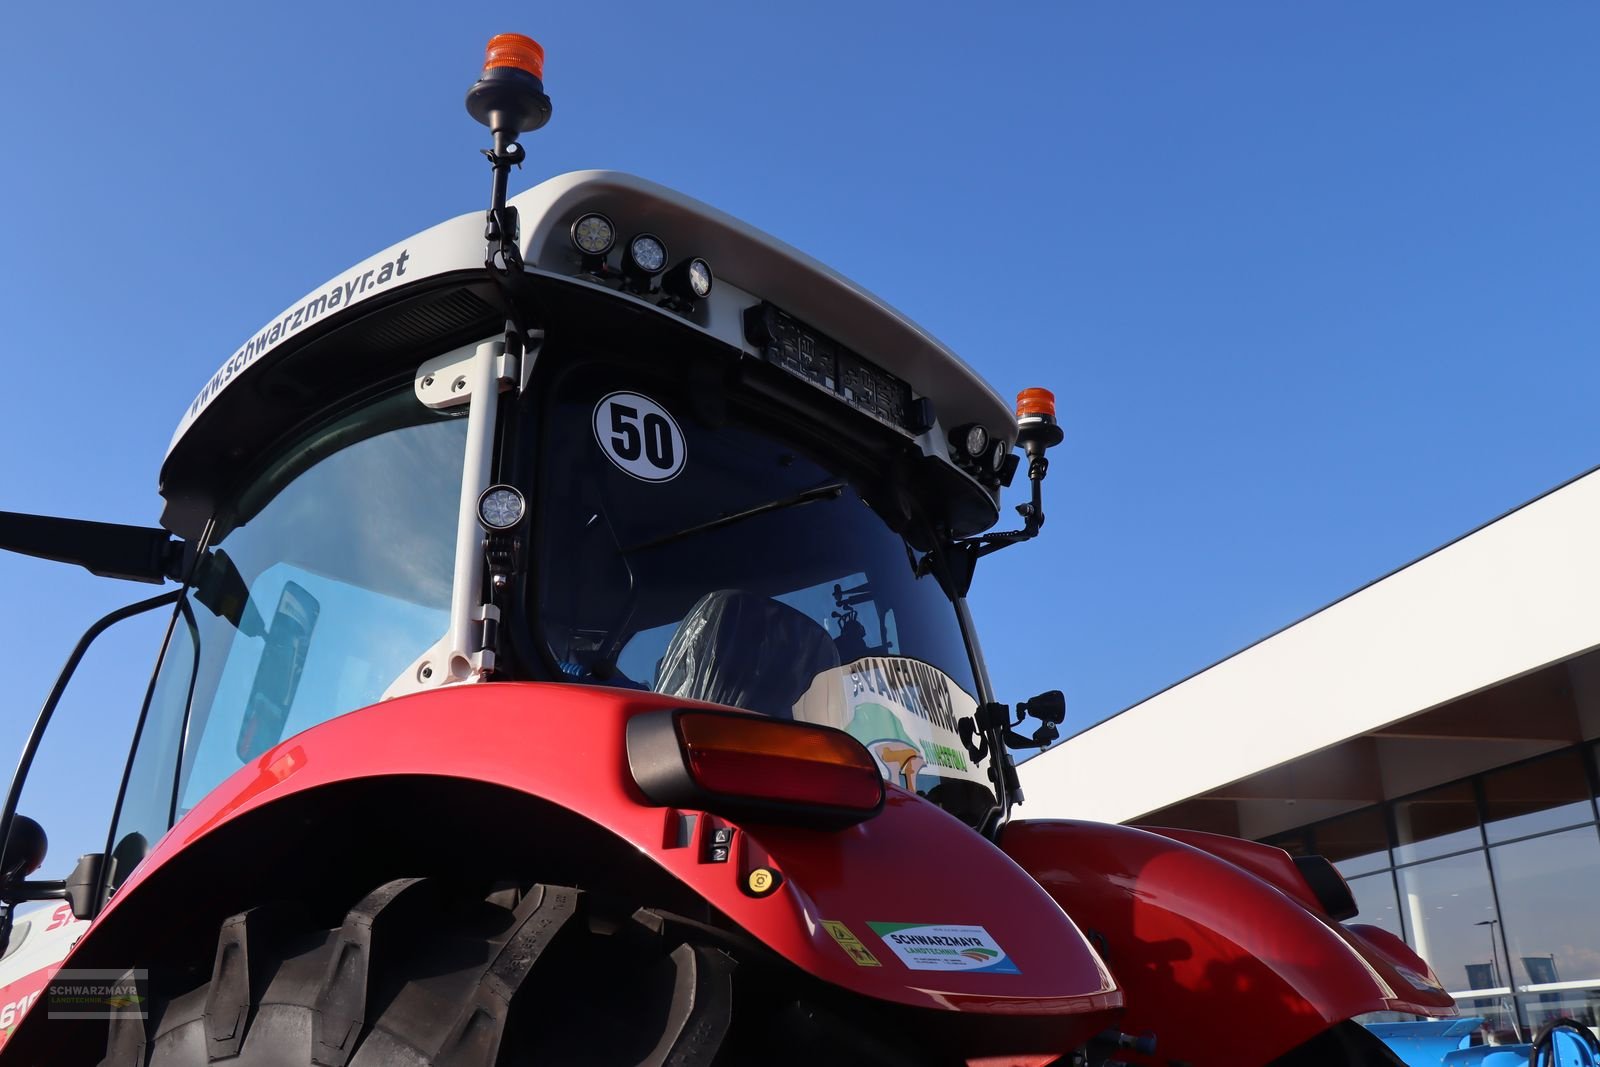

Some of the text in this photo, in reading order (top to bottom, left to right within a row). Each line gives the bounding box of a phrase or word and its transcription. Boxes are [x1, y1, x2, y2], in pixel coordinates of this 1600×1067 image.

[190, 249, 410, 418] www.schwarzmayr.at
[609, 402, 675, 470] 50
[890, 934, 984, 947] SCHWARZMAYR
[904, 947, 960, 956] LANDTECHNIK
